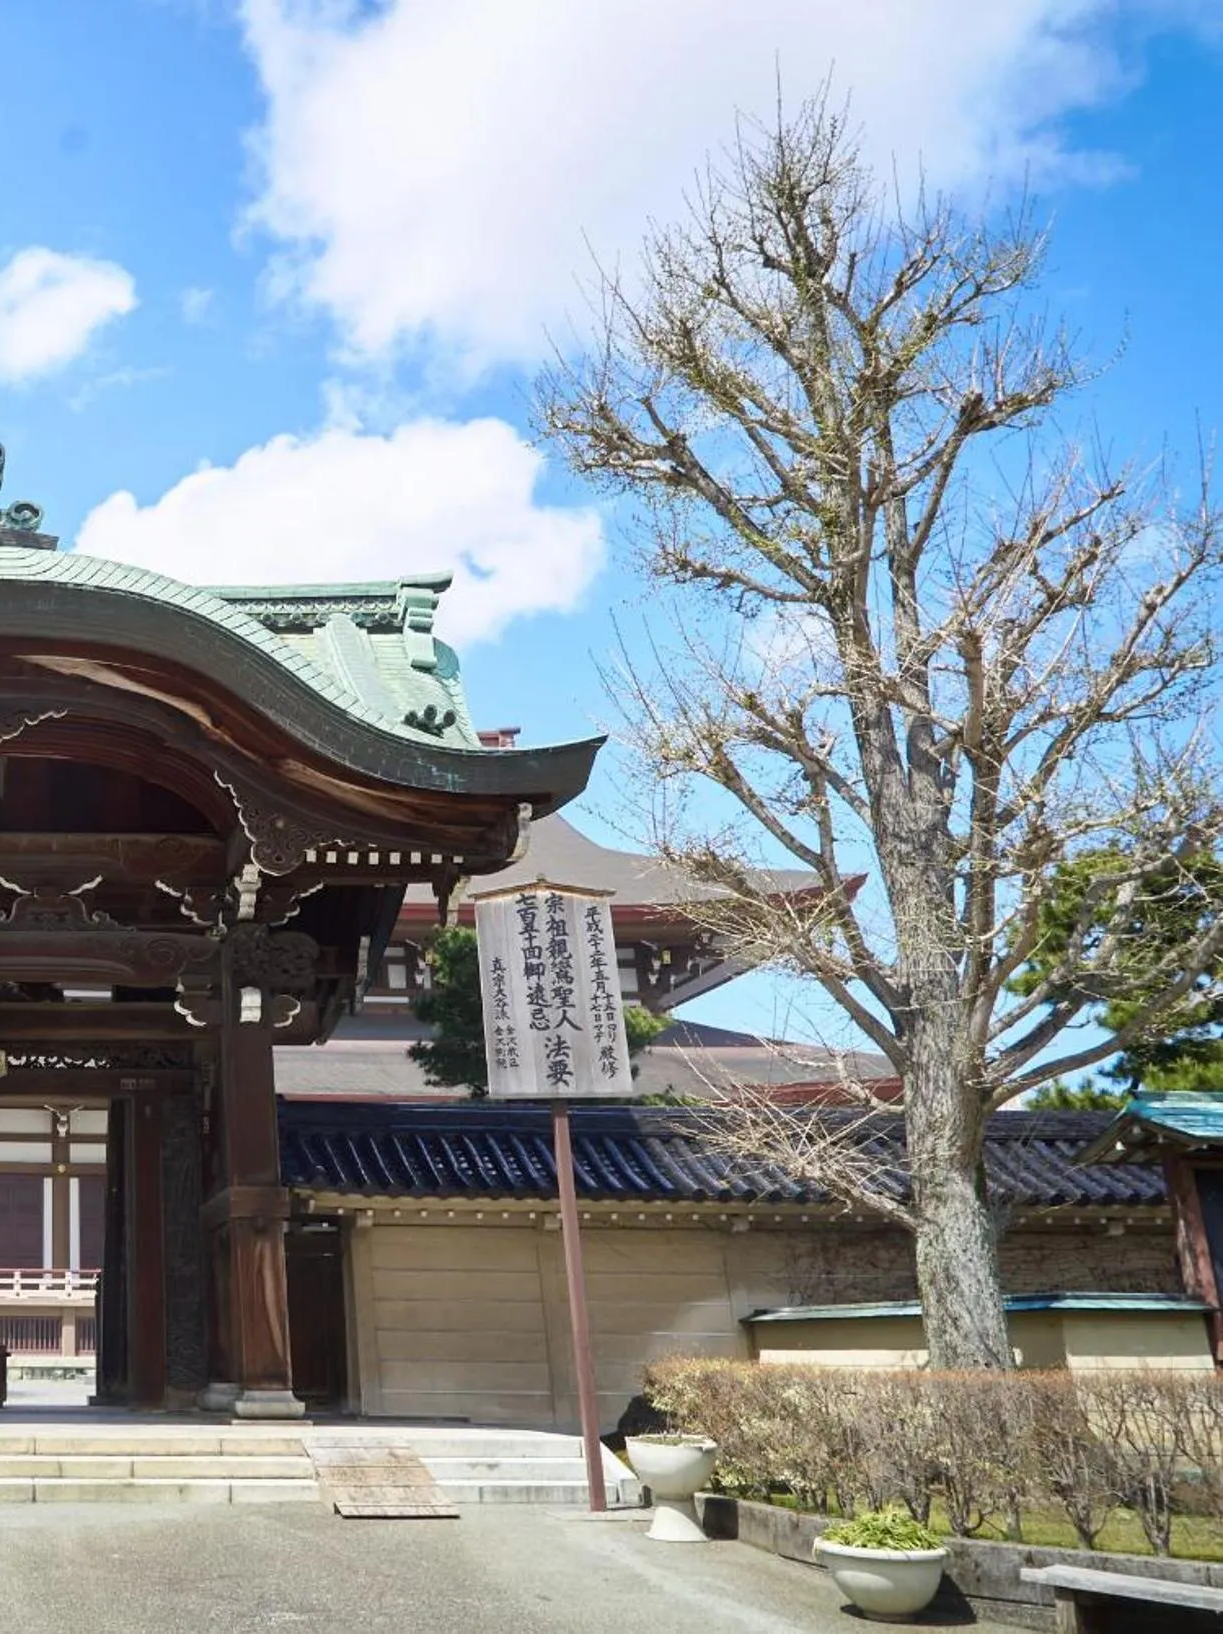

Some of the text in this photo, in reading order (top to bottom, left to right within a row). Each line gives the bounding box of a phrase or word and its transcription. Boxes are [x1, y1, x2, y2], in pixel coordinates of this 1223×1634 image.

[515, 893, 552, 1031] 七百五十回御遠忌
[544, 892, 583, 1031] 宗祖親鸞聖人
[544, 1034, 574, 1087] 法要
